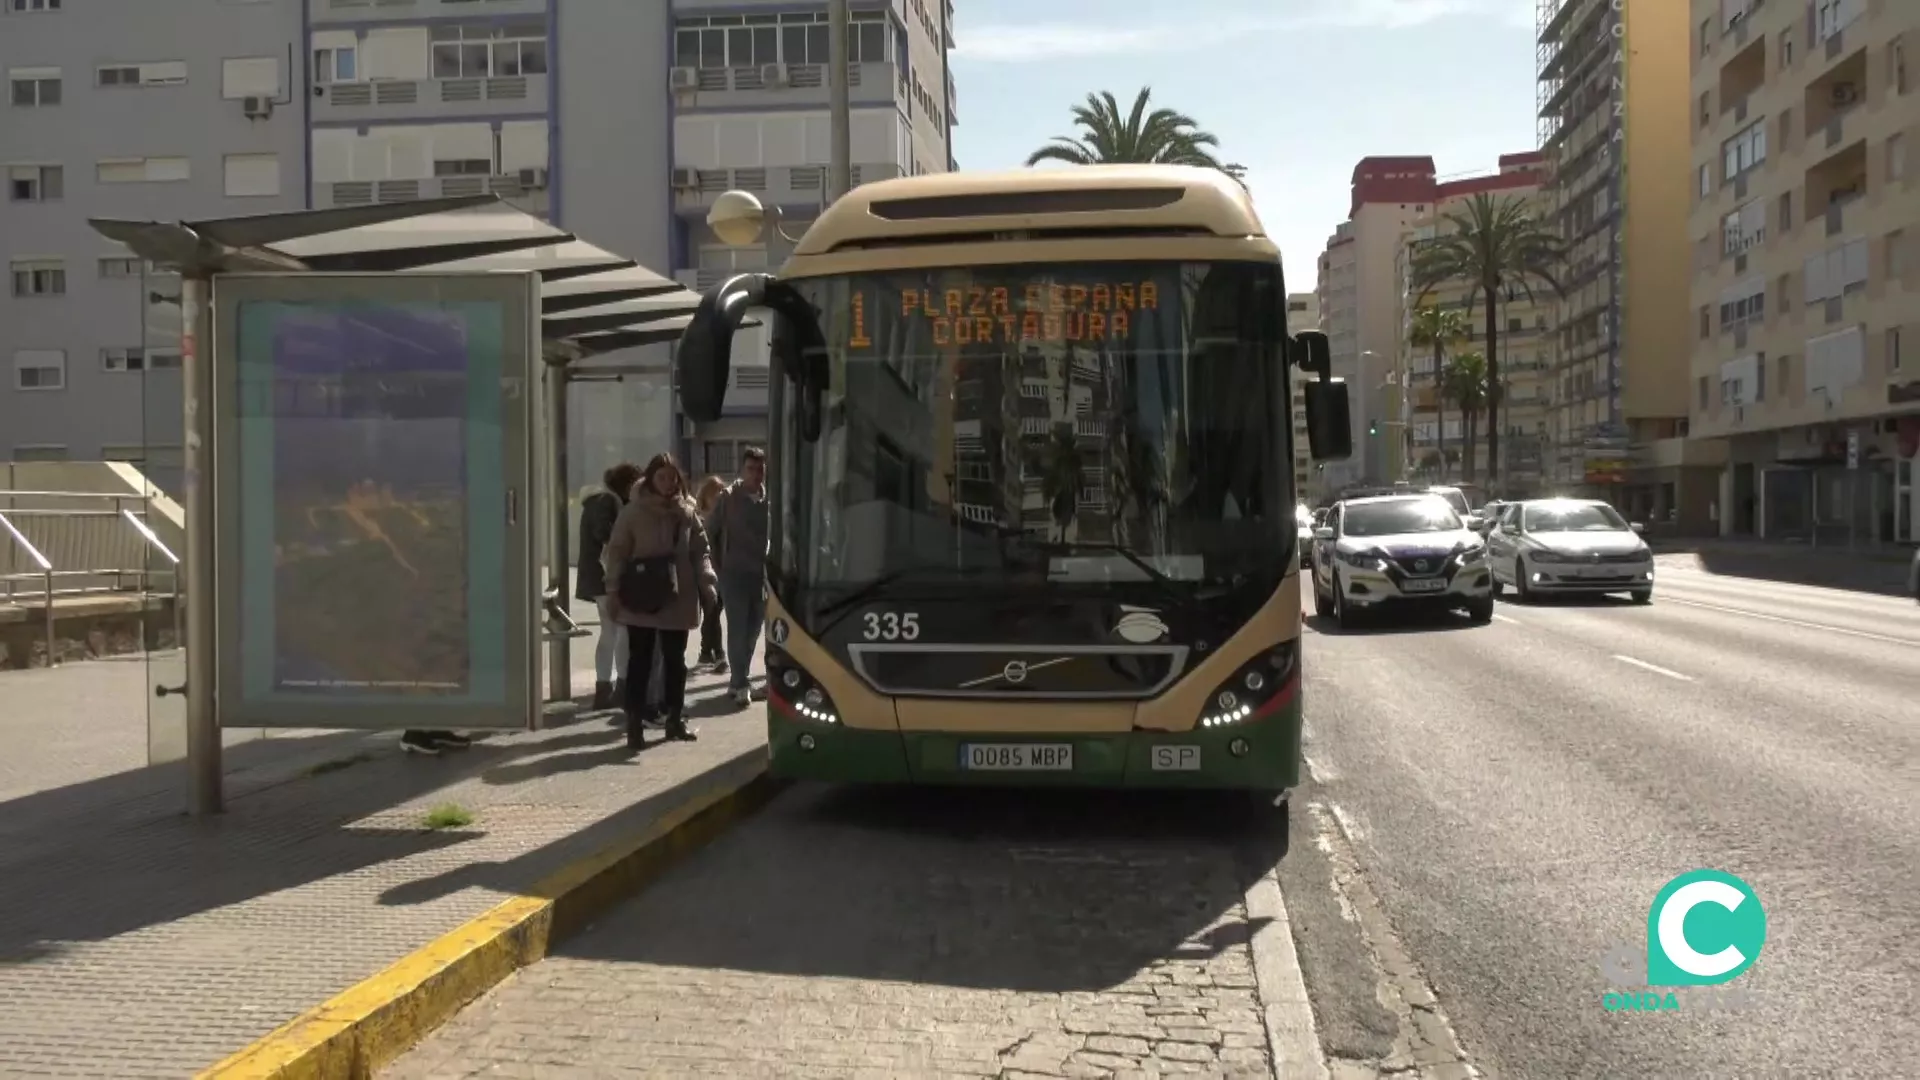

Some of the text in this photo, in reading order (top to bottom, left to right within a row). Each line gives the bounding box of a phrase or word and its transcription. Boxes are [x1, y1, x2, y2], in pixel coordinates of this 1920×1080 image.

[901, 286, 1008, 316] PLAZA
[850, 293, 870, 347] 1
[932, 310, 1129, 344] CORTADURA
[863, 612, 919, 641] 335
[972, 746, 1068, 766] 0085 MBP
[1158, 748, 1193, 767] SP
